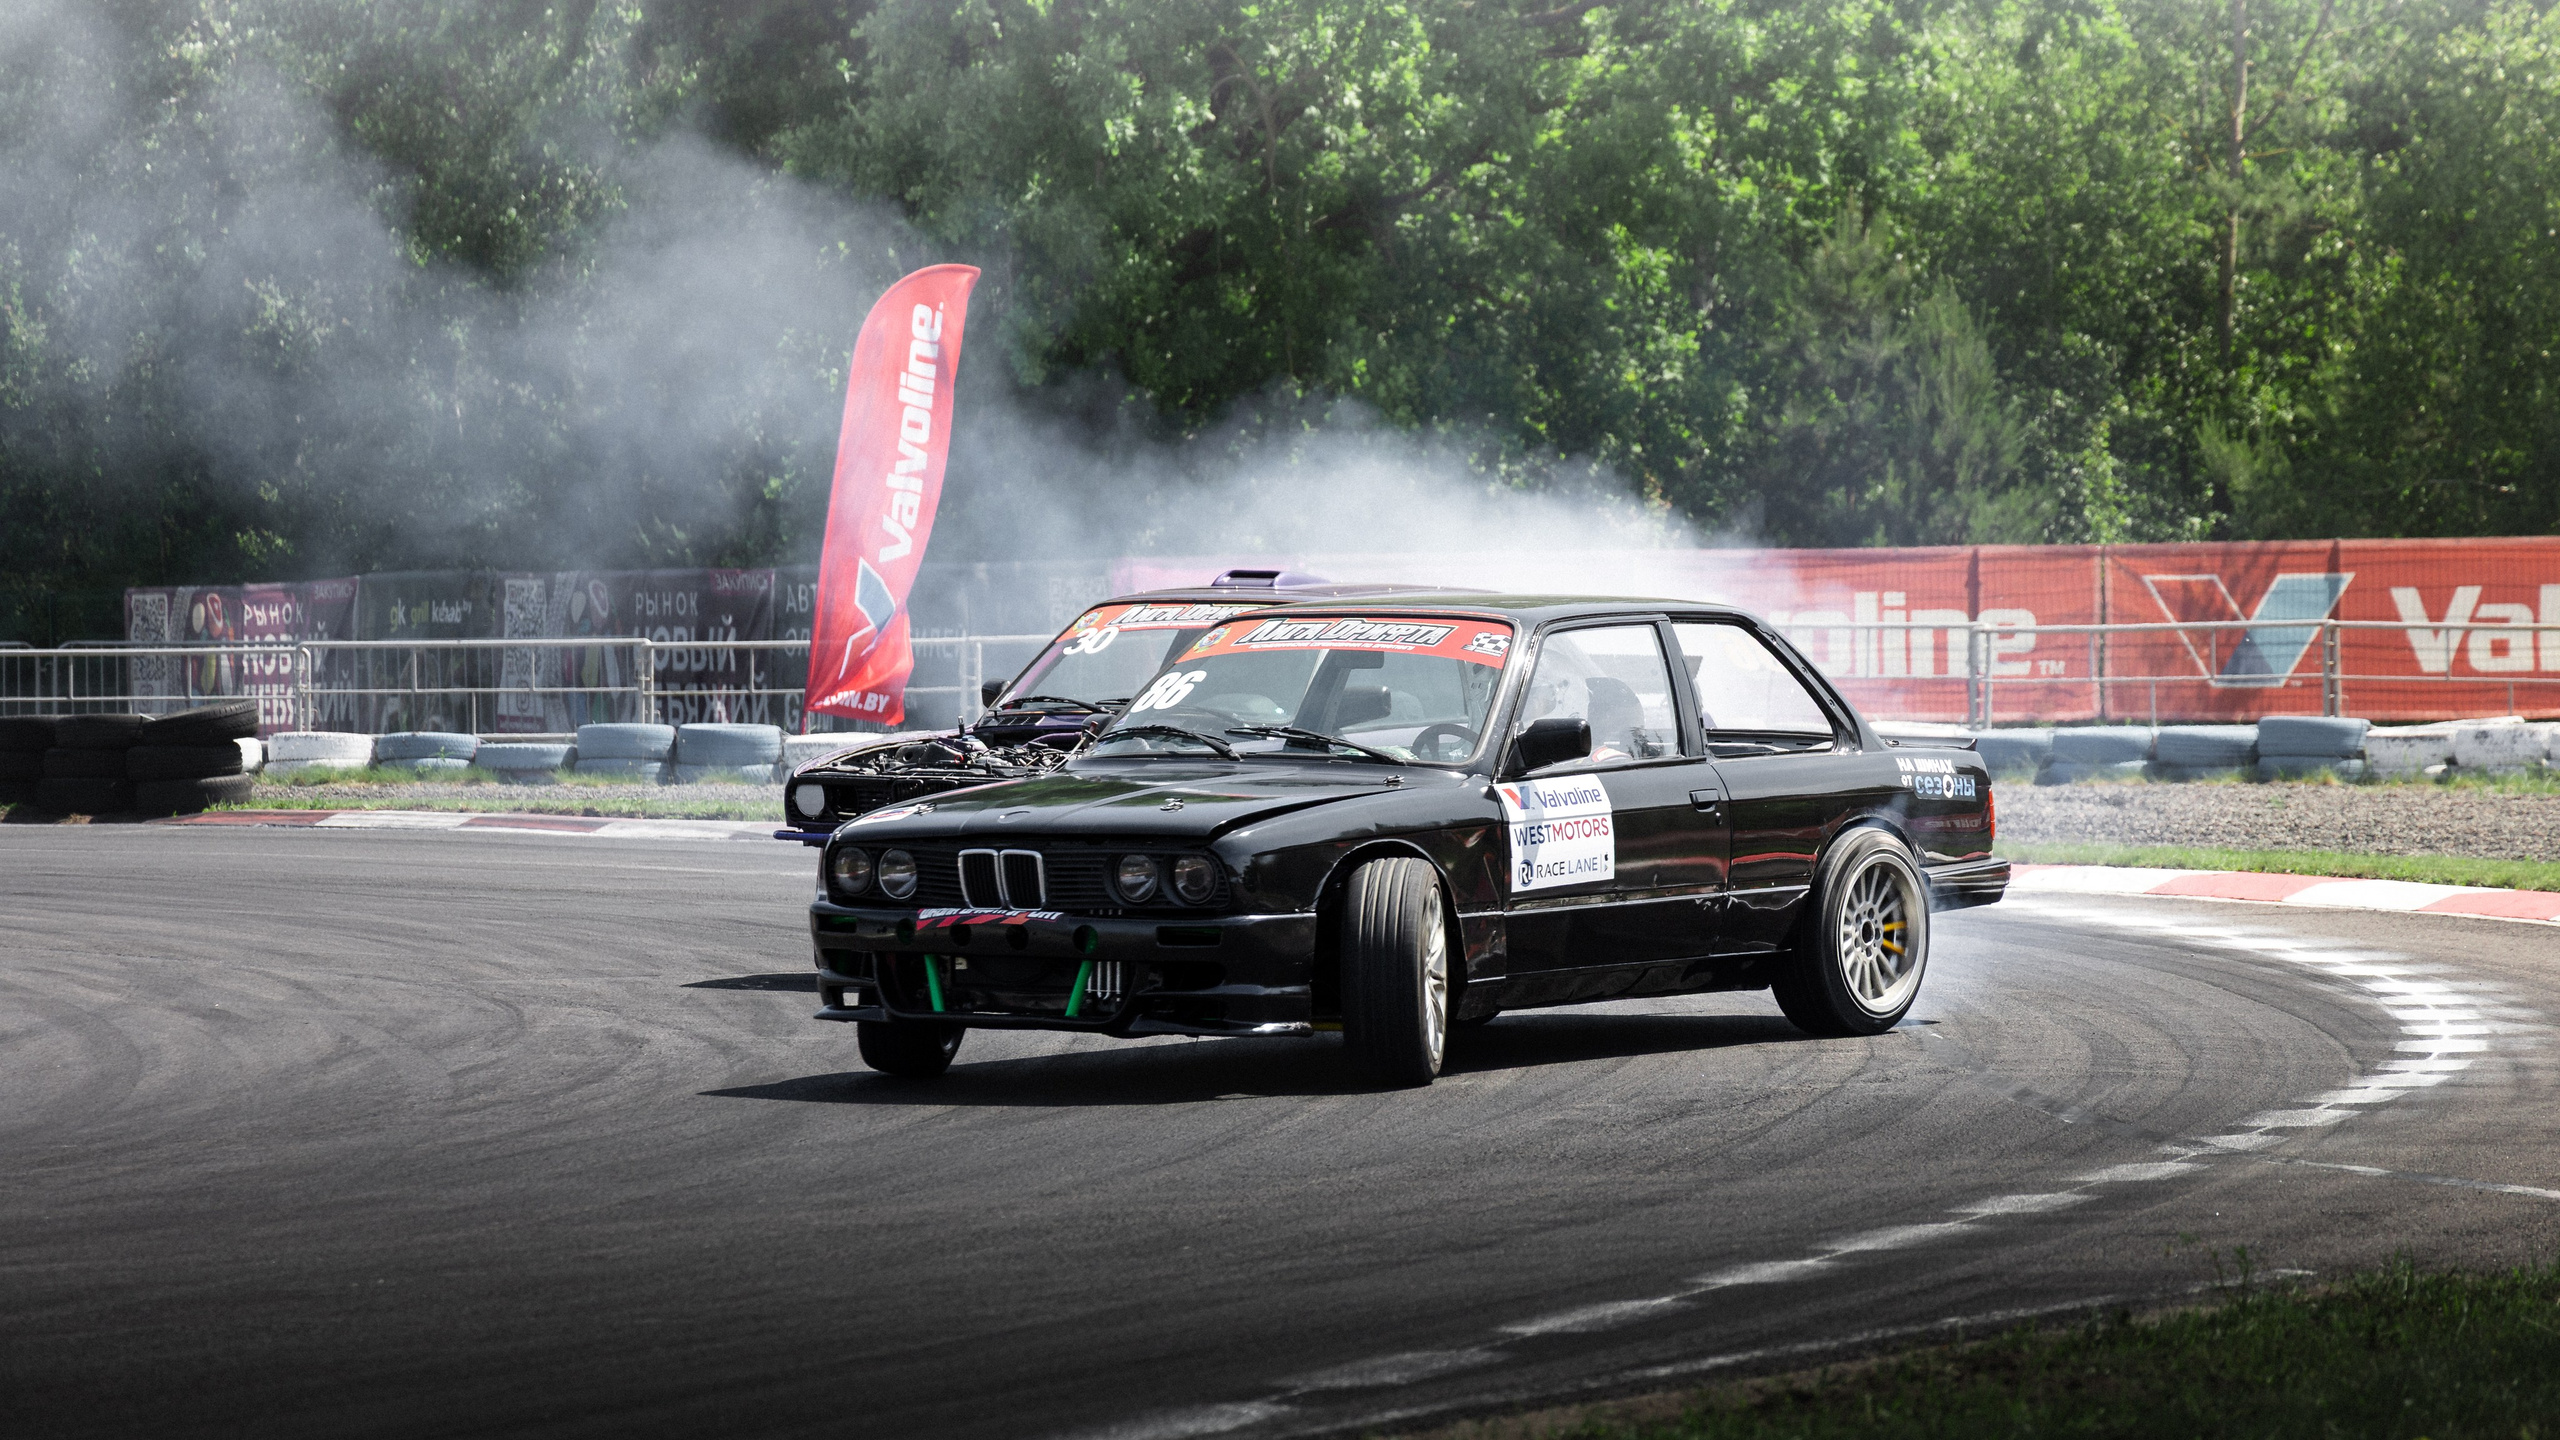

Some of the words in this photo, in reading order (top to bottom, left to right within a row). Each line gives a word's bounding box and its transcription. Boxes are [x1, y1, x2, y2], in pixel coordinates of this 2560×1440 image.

[878, 302, 943, 563] Valvoline
[242, 602, 304, 628] РЫНОК
[635, 591, 698, 617] РЫНОК
[1062, 627, 1120, 655] 30
[1130, 670, 1208, 713] 86
[1895, 757, 1915, 772] НА
[1914, 758, 1956, 774] ШИНАХ
[1534, 786, 1603, 809] Valvoline
[1514, 817, 1609, 847] WESTMOTORS
[1536, 861, 1566, 879] RACE
[1568, 857, 1598, 875] LANE
